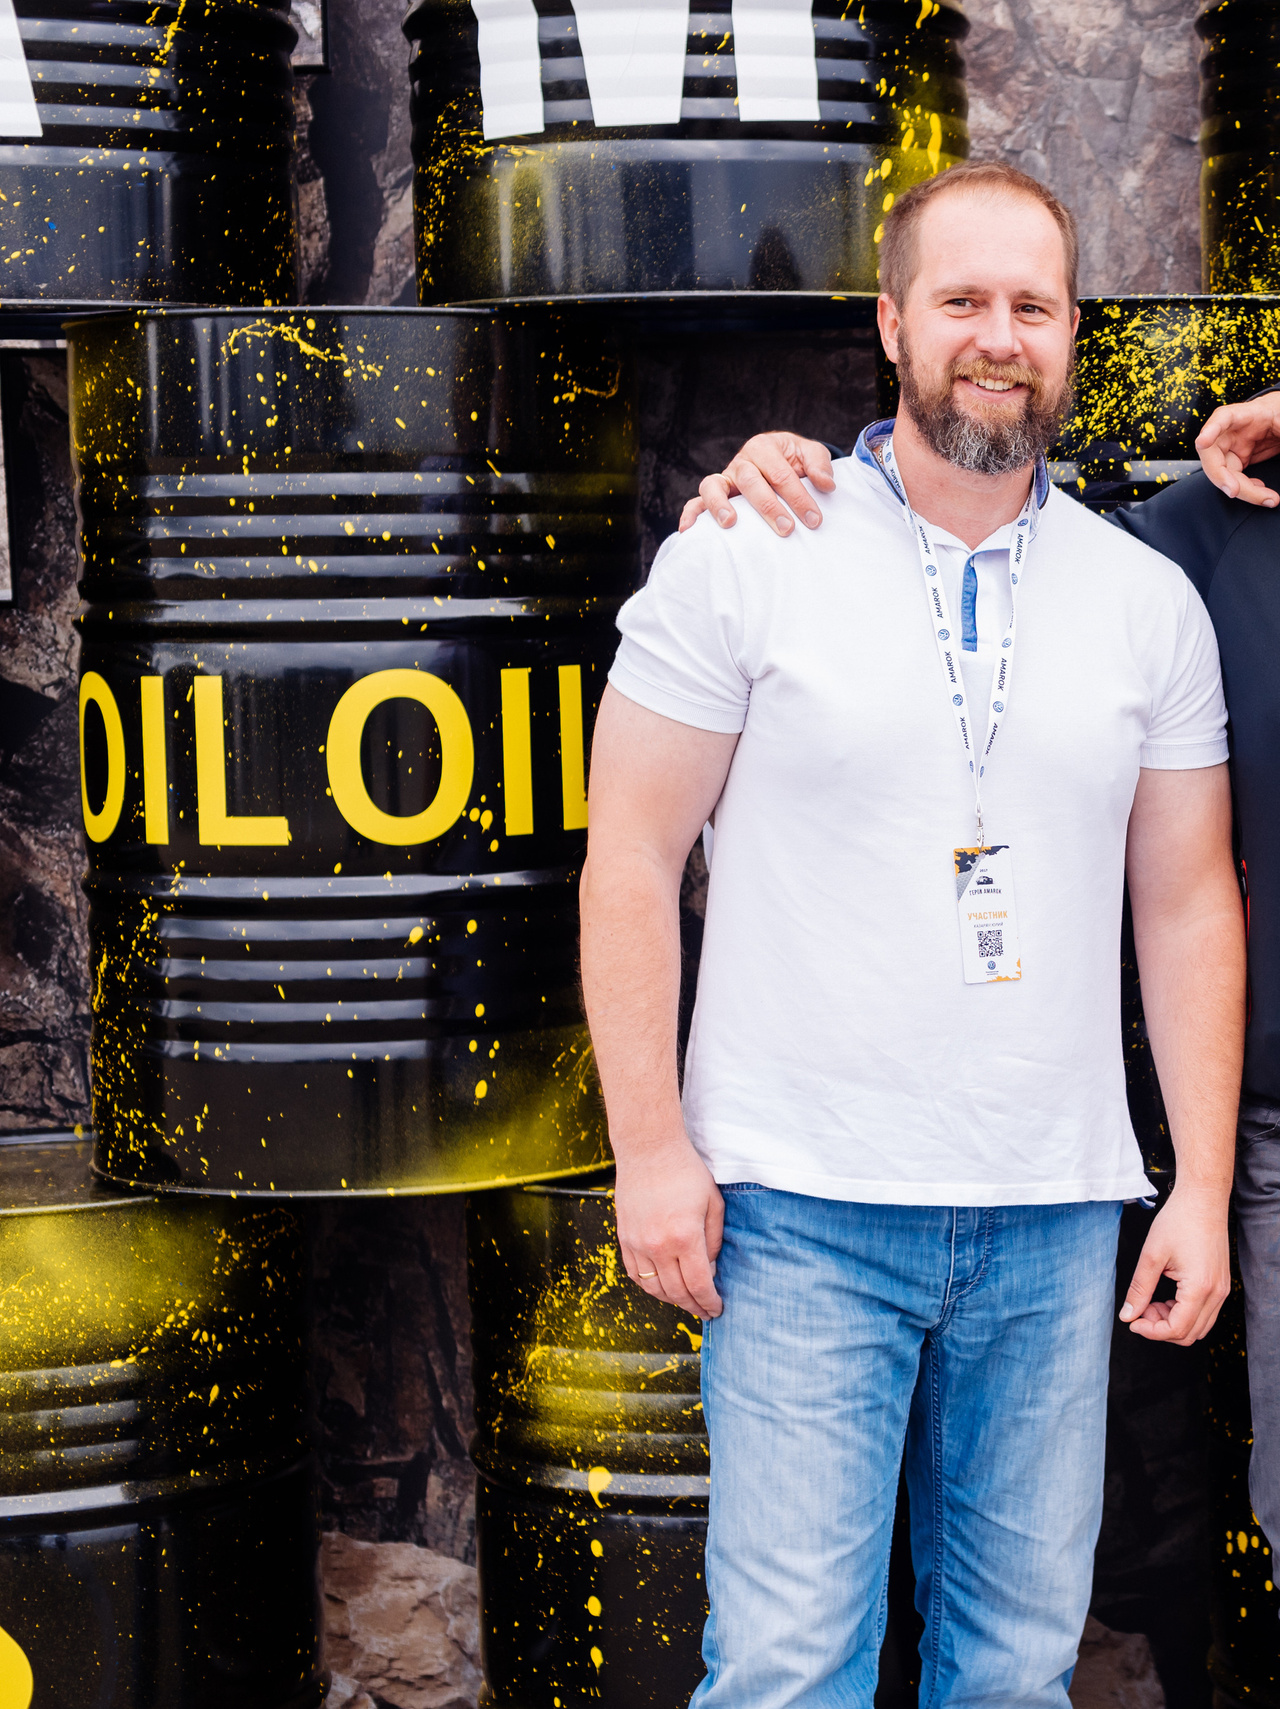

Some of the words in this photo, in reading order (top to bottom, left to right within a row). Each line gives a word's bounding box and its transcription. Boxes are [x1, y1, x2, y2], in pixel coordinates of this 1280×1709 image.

[1014, 533, 1024, 565] AMAROK
[931, 586, 944, 618] AMAROK
[944, 651, 957, 684] AMAROK
[997, 657, 1007, 691] AMAROK
[959, 716, 970, 750] AMAROK
[984, 722, 998, 756] AMAROK
[79, 671, 290, 846] OIL
[326, 664, 590, 846] OIL
[967, 910, 1008, 921] УЧАСТНИК
